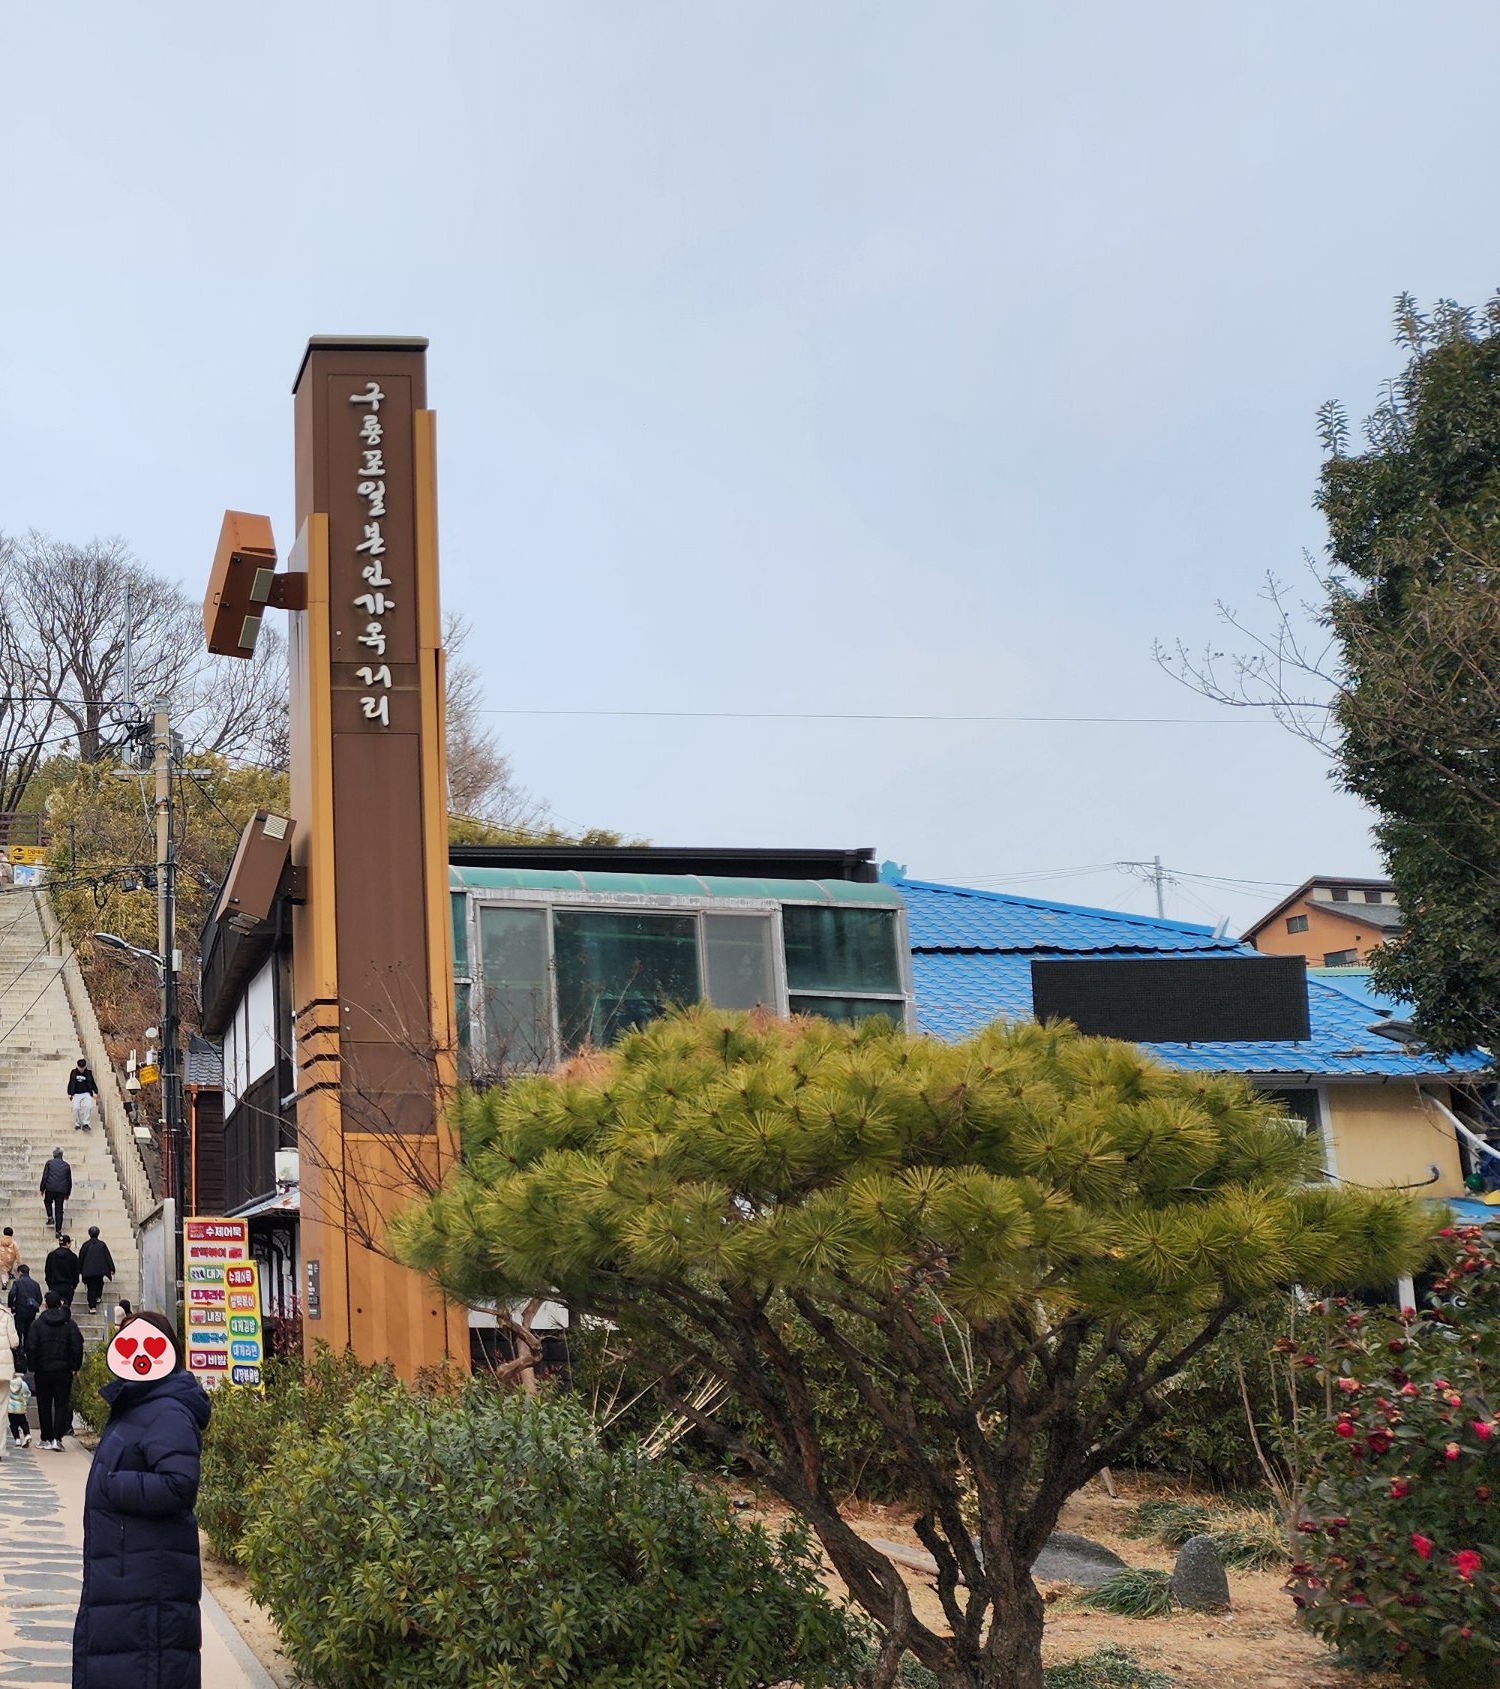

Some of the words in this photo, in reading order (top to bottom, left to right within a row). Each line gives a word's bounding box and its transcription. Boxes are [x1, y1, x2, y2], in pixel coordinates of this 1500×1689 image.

[206, 1226, 242, 1237] 수제어묵
[206, 1268, 224, 1279] 대게
[229, 1270, 252, 1283] 수제어묵
[230, 1295, 255, 1309] 쌀떡볶이
[207, 1311, 226, 1323] 내장
[231, 1320, 256, 1333] 대게김밥
[233, 1344, 258, 1358] 대게라면
[208, 1354, 228, 1366] 비빔
